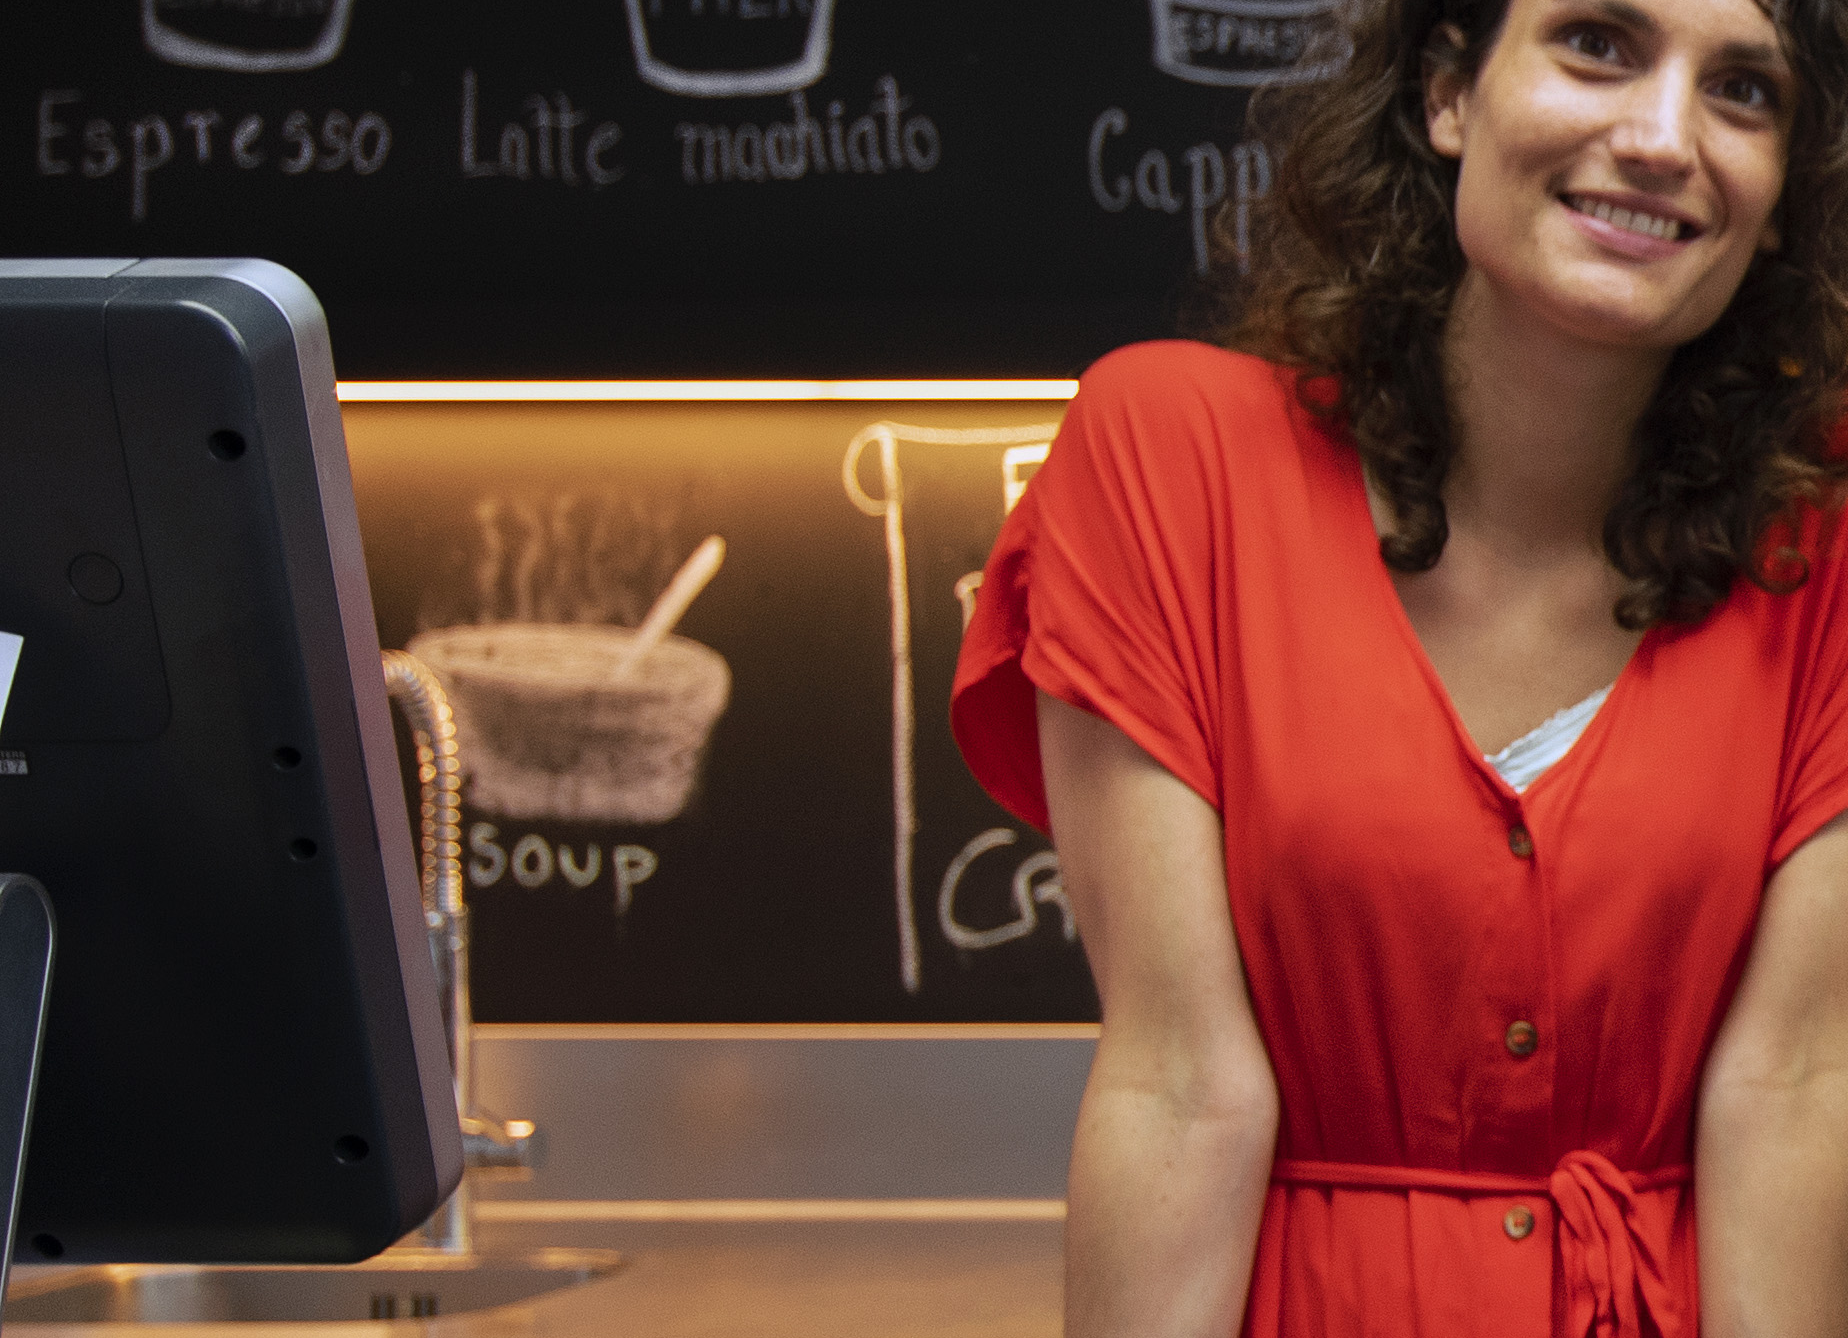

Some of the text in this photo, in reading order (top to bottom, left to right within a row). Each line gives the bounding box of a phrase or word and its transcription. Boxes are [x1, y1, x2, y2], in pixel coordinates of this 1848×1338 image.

[38, 88, 393, 221] Espresso
[460, 69, 625, 187] Latte
[1088, 105, 1273, 277] Capp
